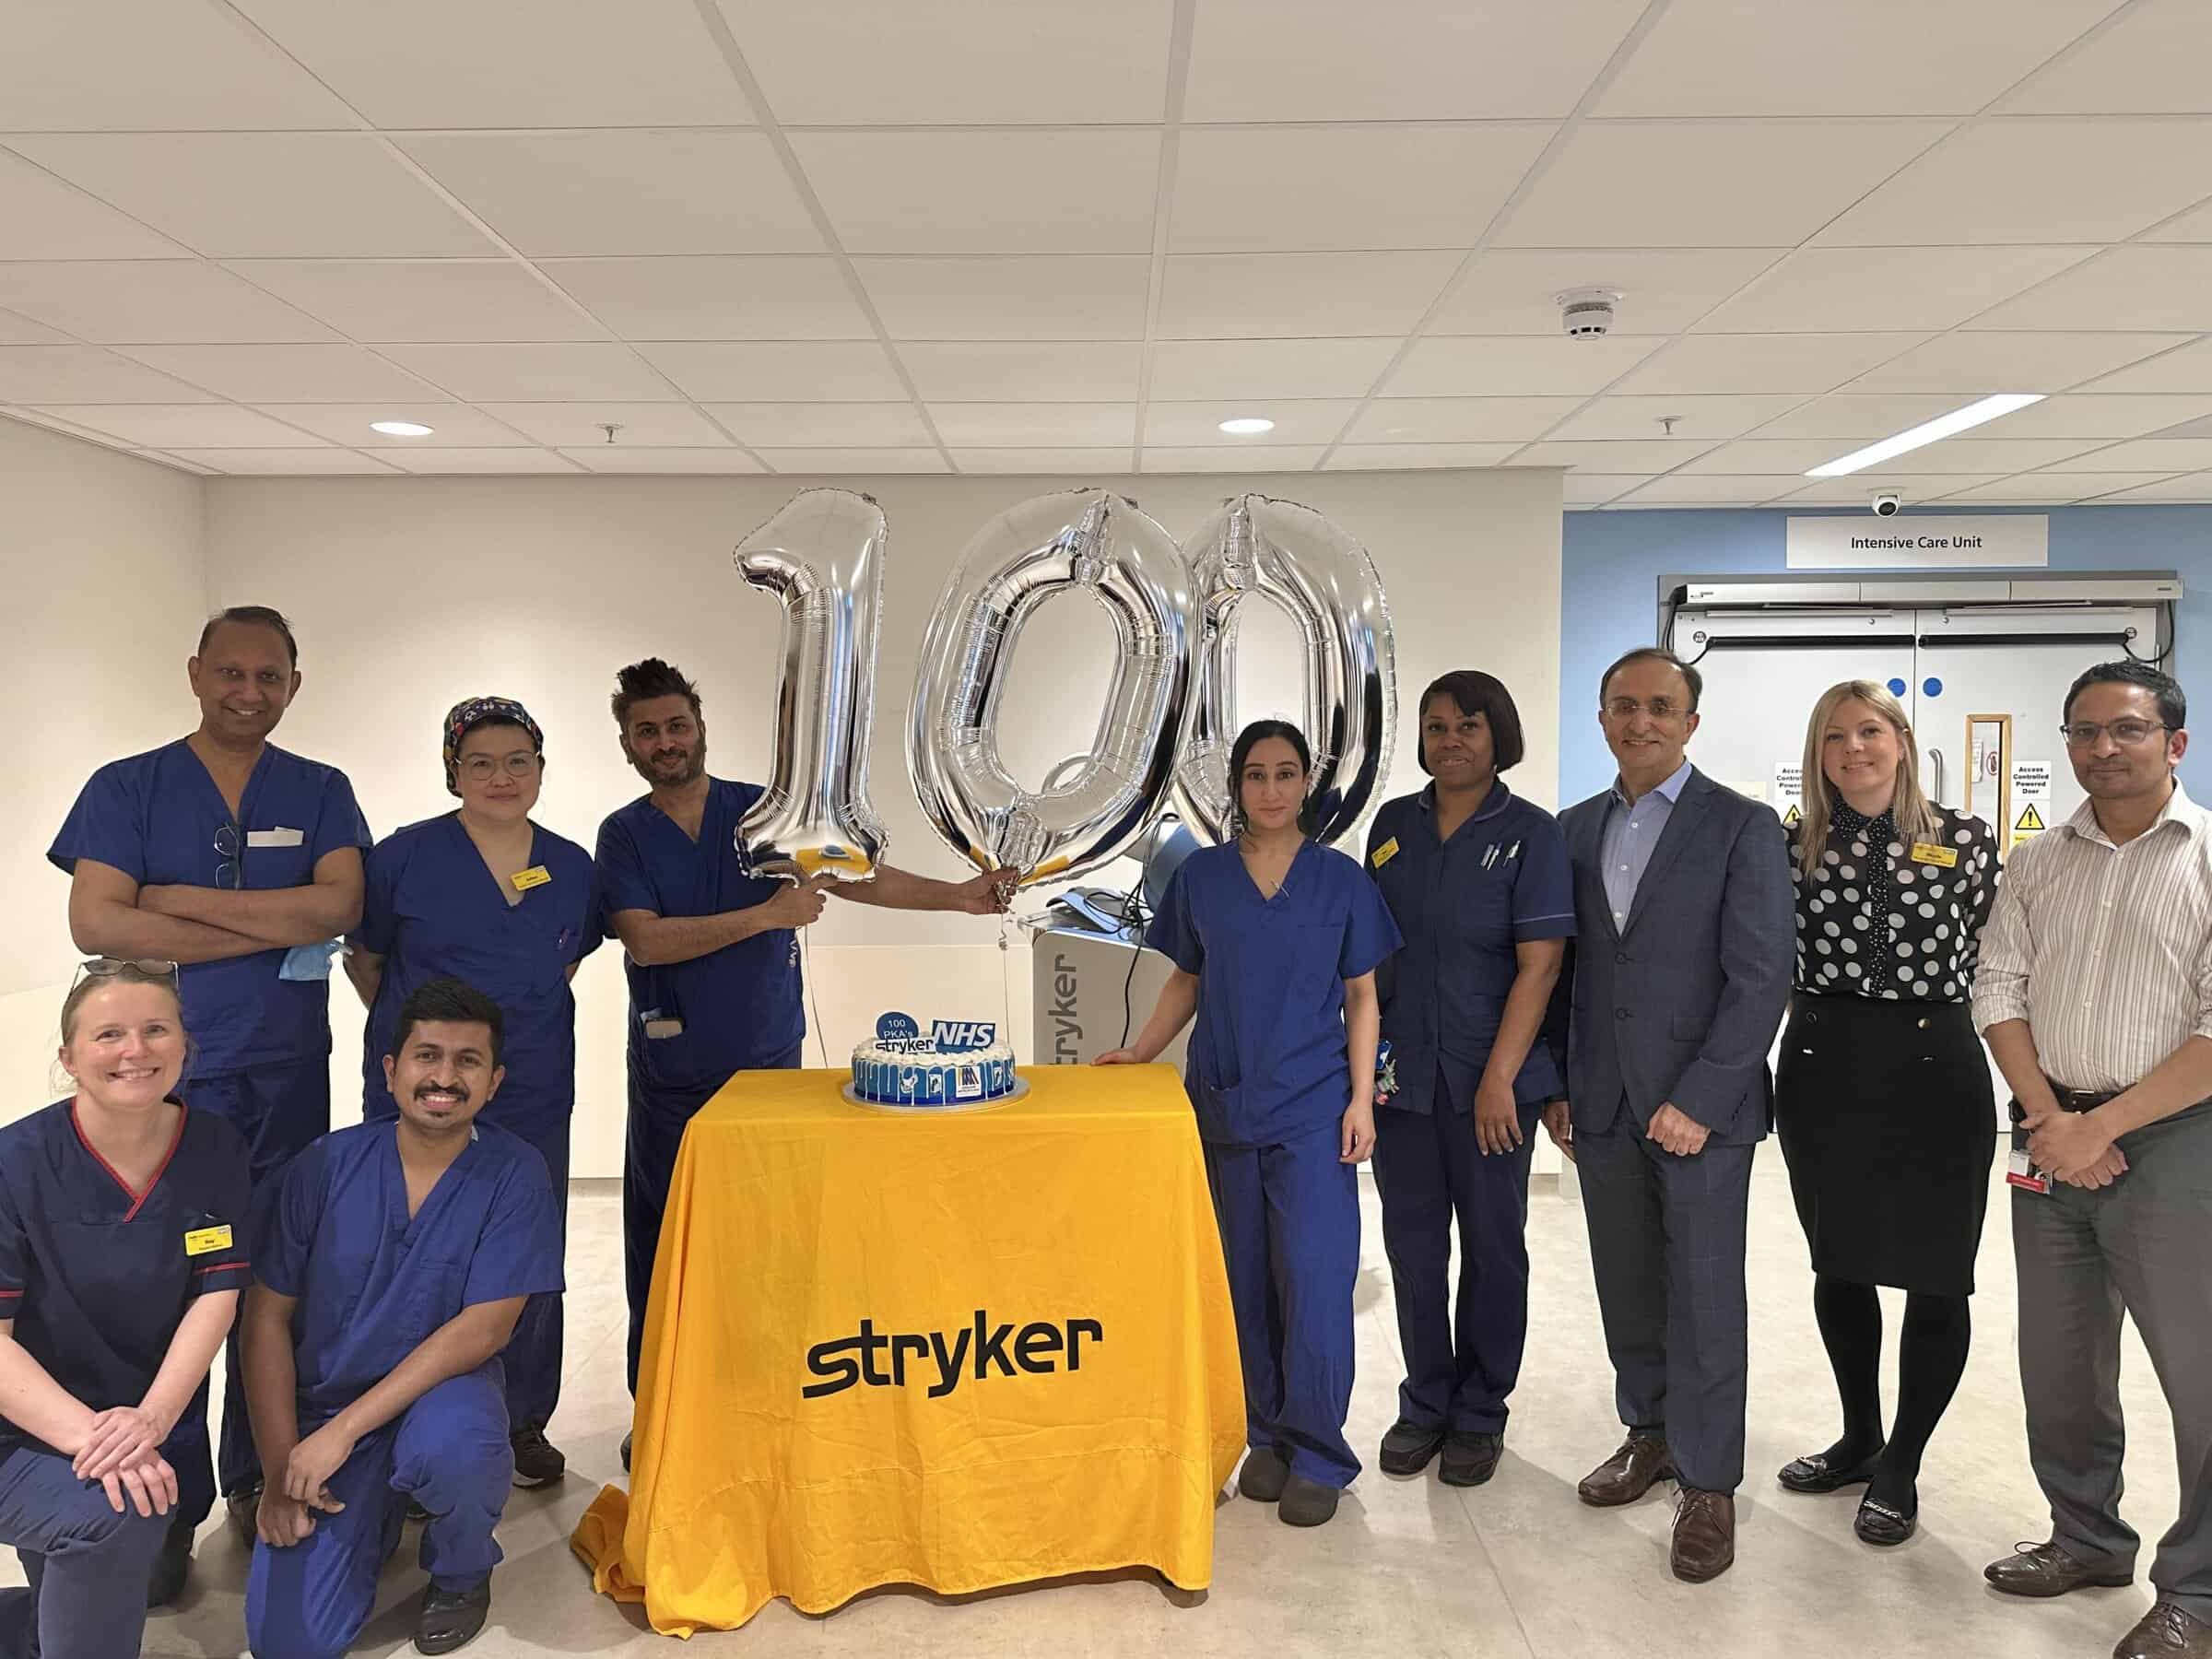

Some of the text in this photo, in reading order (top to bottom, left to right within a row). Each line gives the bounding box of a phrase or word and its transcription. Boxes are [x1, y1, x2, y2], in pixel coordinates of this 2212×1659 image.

[1851, 535, 1983, 548] Intensive Care Unit
[735, 487, 1397, 885] 100
[1047, 953, 1083, 1065] ryker
[888, 1019, 906, 1028] 100
[884, 1030, 913, 1039] PKA's
[935, 1022, 994, 1047] NHS
[875, 1037, 935, 1055] stryker
[802, 1310, 1103, 1399] stryker
